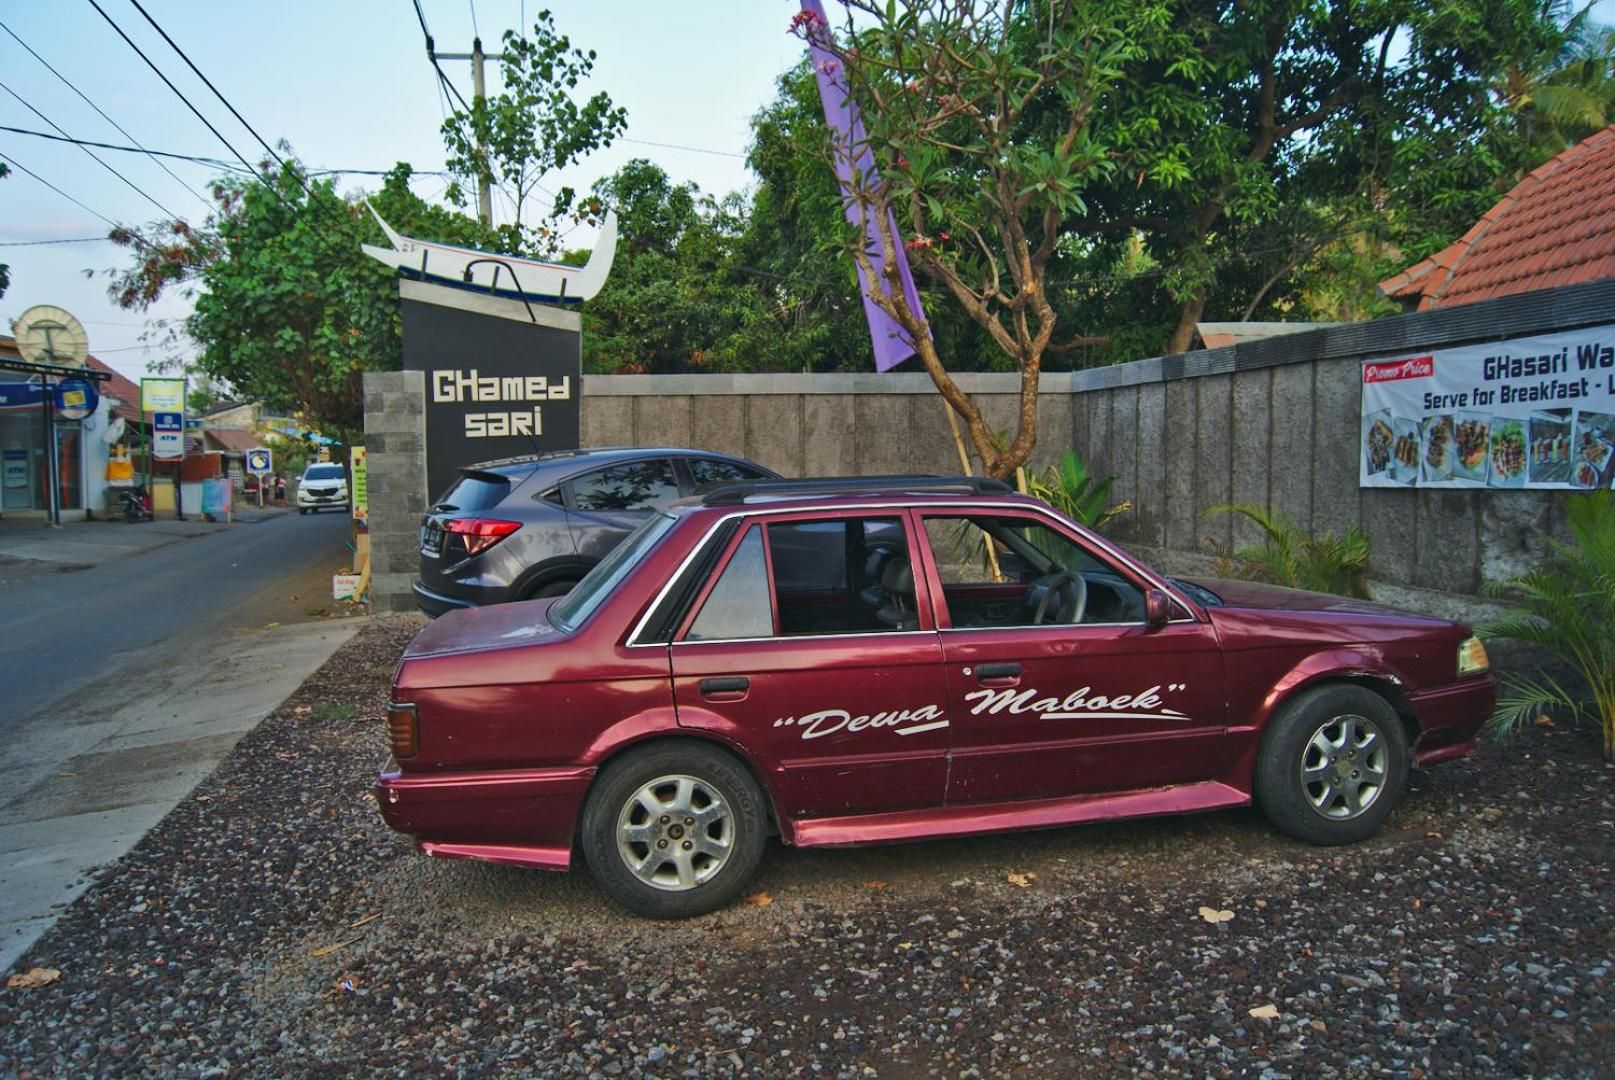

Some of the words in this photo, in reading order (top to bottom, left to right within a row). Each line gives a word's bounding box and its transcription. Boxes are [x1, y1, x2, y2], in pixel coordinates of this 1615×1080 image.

[1366, 365, 1399, 381] Promo
[1400, 360, 1432, 377] Price
[1483, 347, 1568, 381] GHasari
[1424, 392, 1468, 410] Serve
[1473, 388, 1495, 406] for
[1500, 377, 1589, 404] Breakfast
